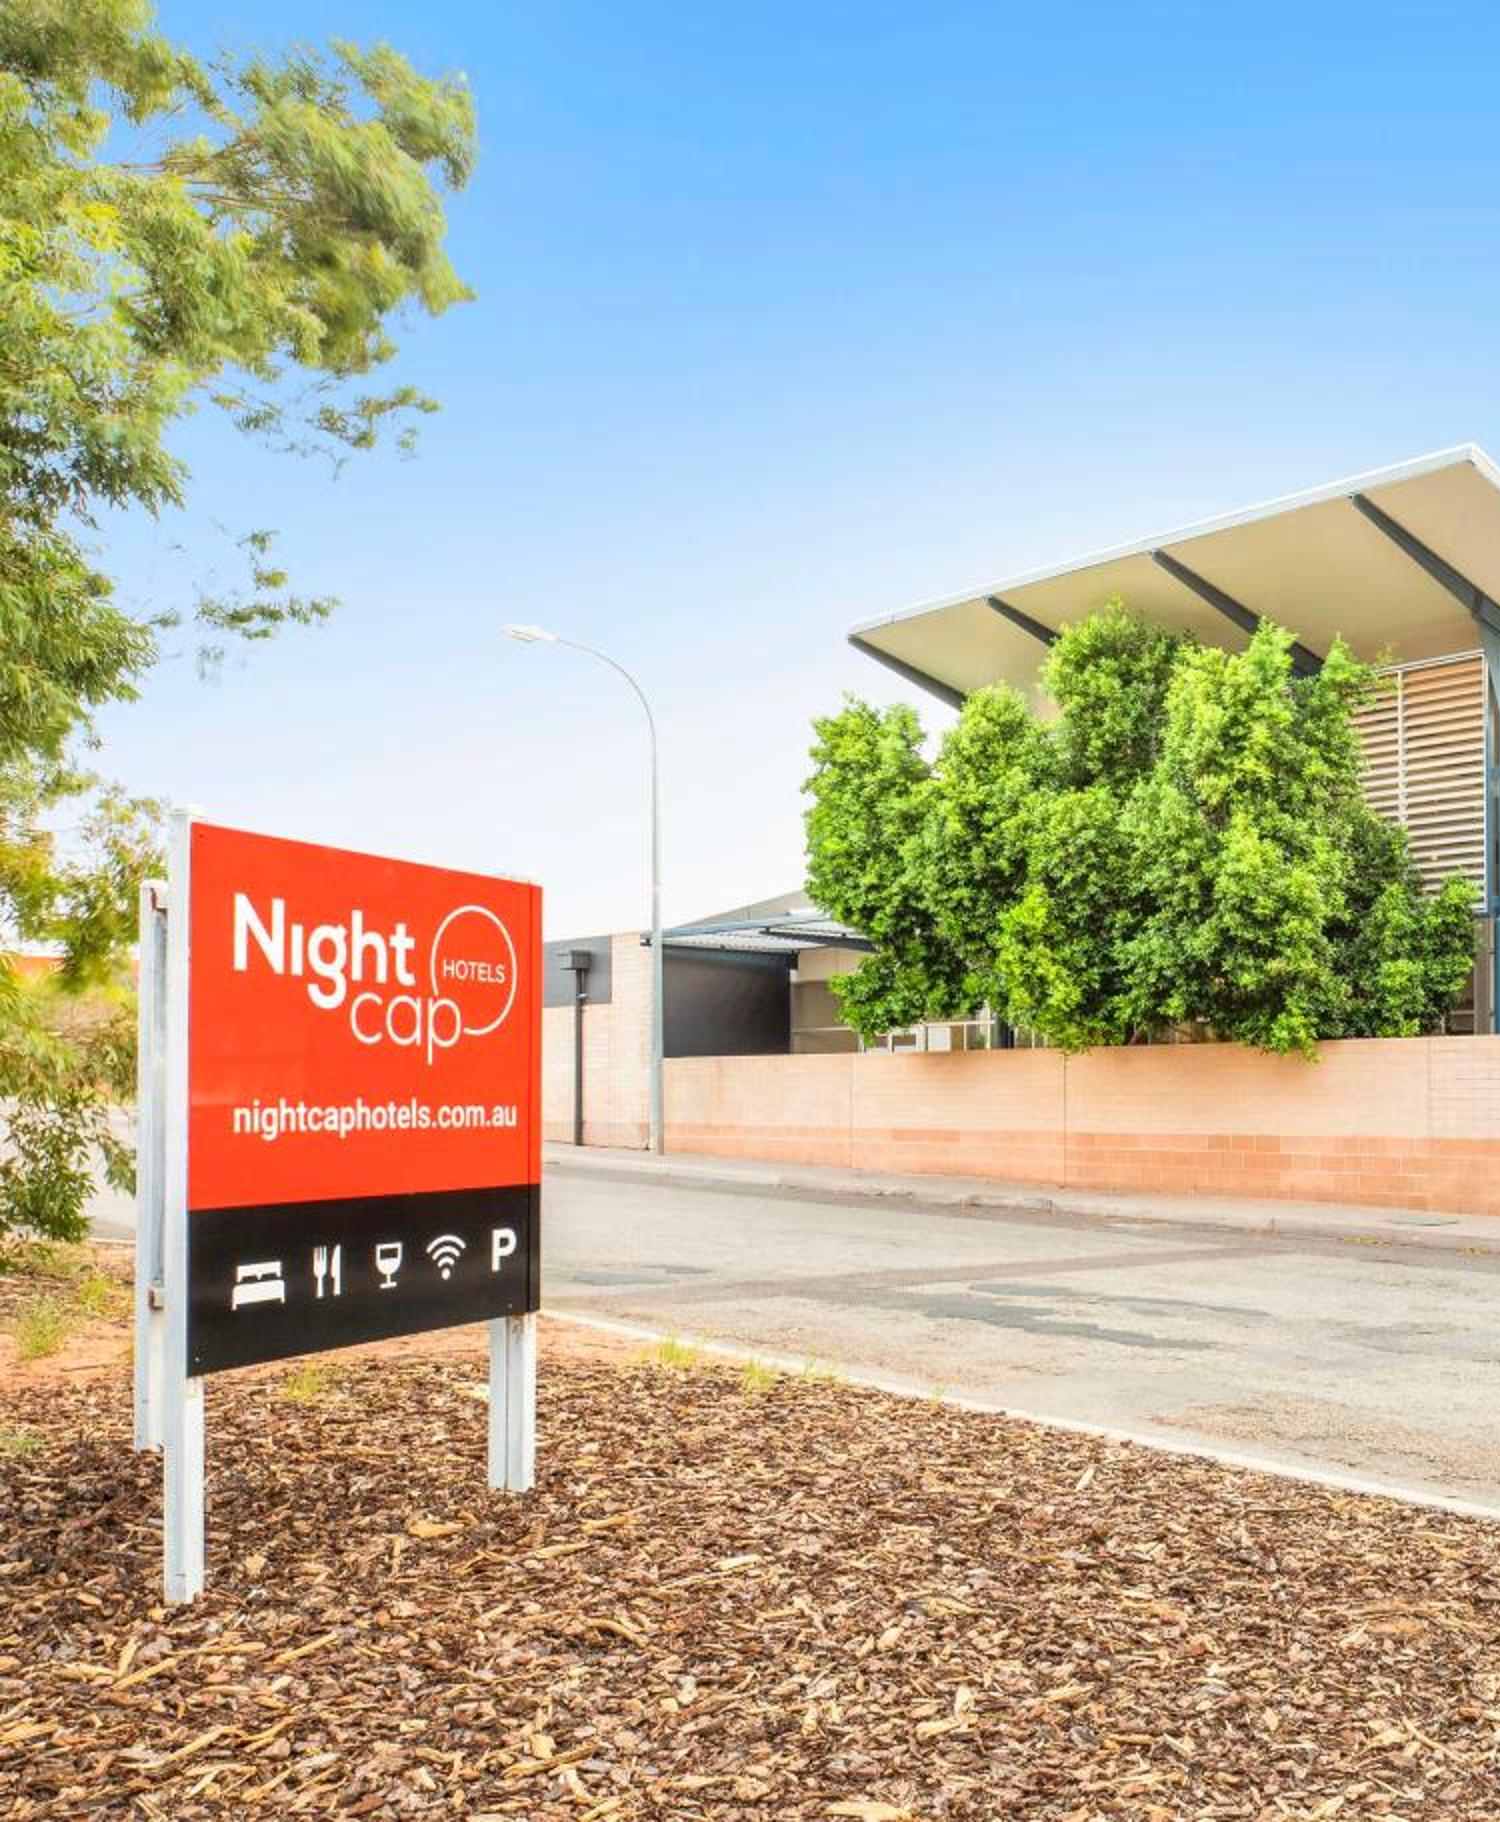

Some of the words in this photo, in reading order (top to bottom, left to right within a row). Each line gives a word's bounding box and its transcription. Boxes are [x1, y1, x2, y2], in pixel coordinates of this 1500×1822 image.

[233, 892, 415, 1010] Night
[443, 960, 505, 983] HOTELS
[351, 992, 461, 1066] cap
[233, 1097, 517, 1141] nightcaphotels.com.au
[491, 1227, 517, 1273] P
